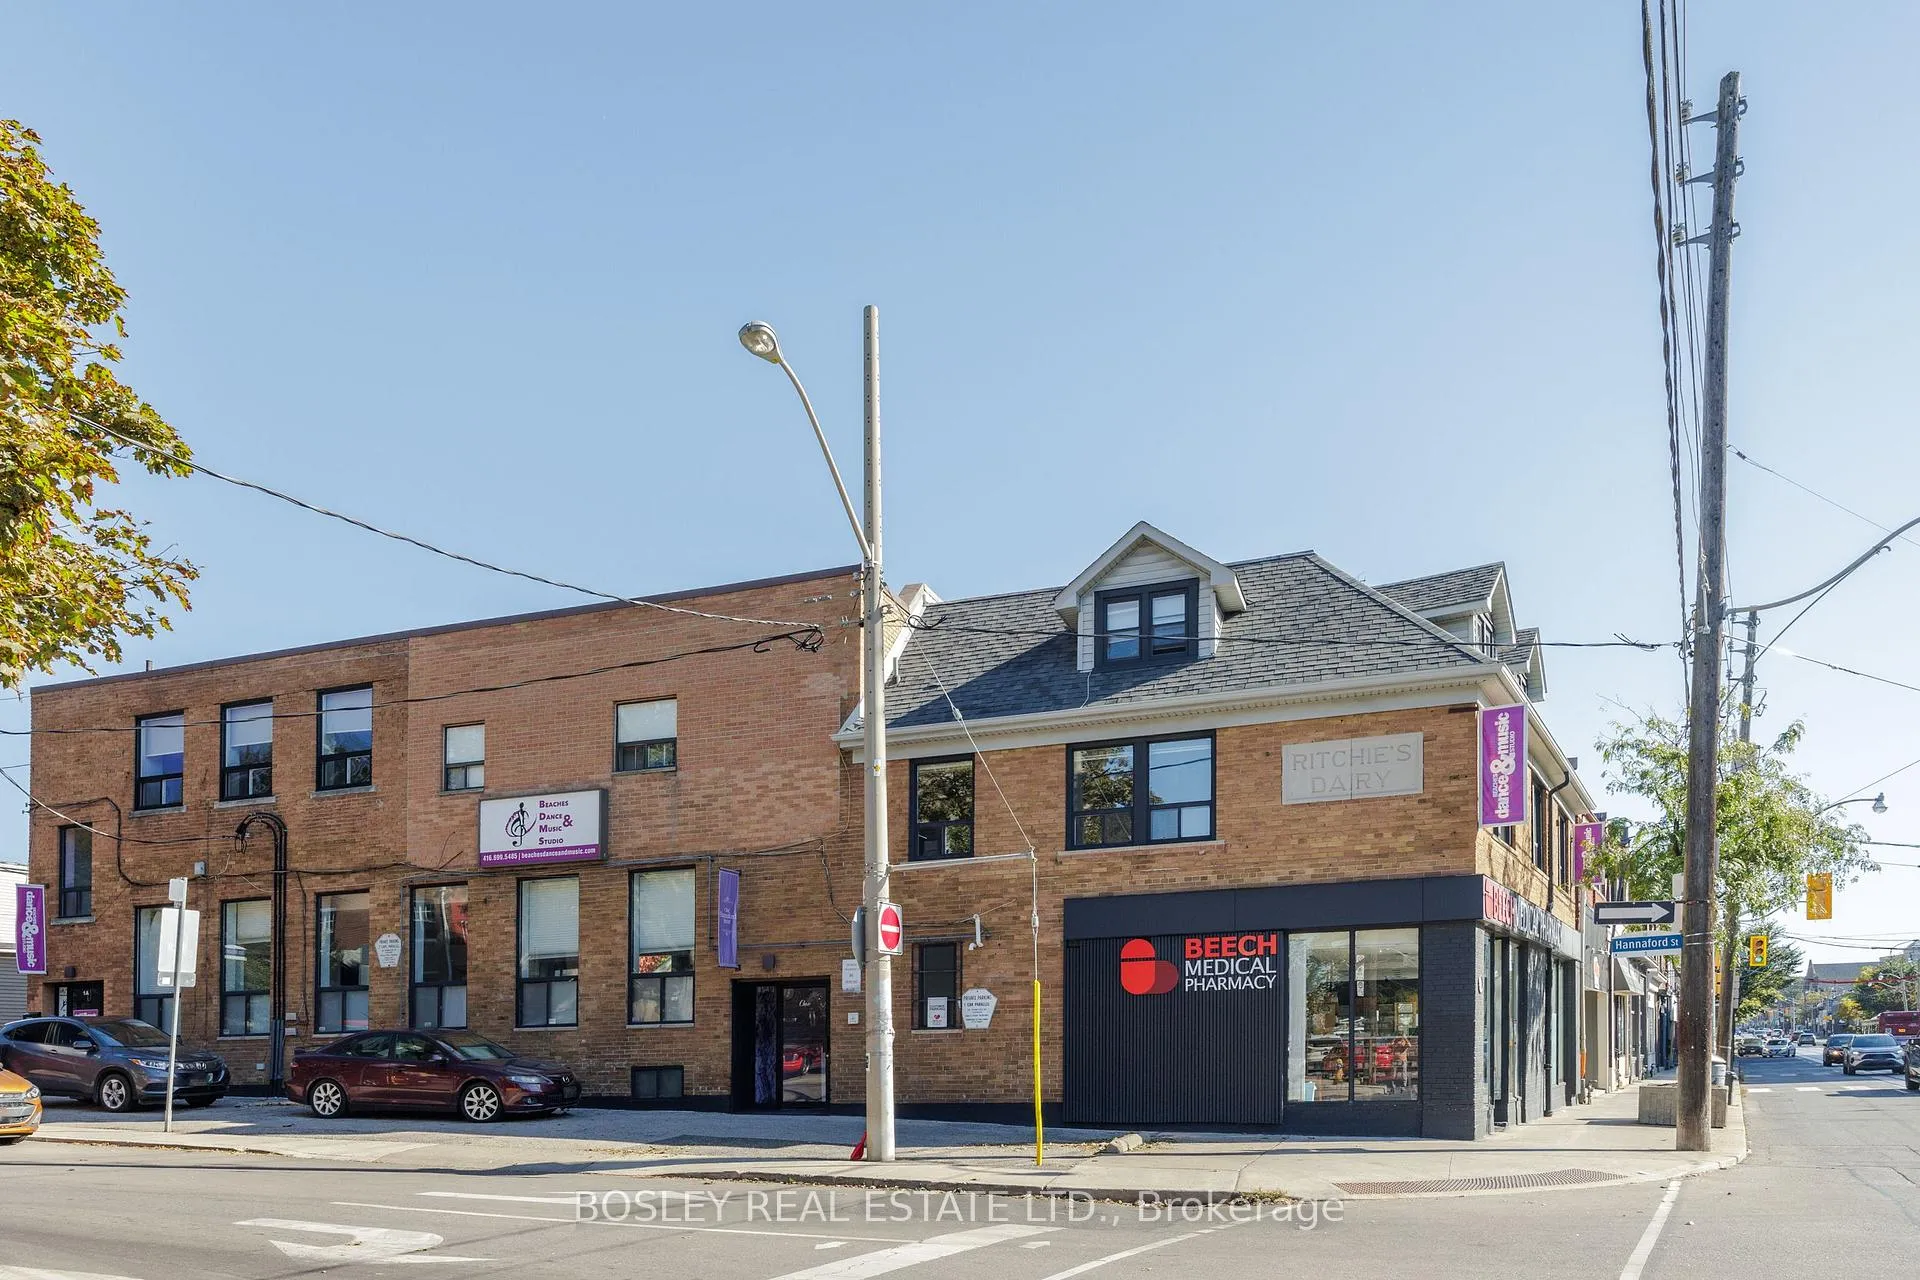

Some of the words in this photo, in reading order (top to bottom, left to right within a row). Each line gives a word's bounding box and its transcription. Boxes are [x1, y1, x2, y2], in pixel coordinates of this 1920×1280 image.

[1292, 744, 1412, 771] RITCHIE'S
[1311, 770, 1391, 794] DAIRY
[539, 800, 569, 809] BEACHES
[539, 812, 563, 821] DANCE
[539, 825, 562, 833] MUSIC
[538, 837, 564, 846] STUDIO
[1185, 934, 1277, 958] BEECH
[1615, 937, 1668, 950] Hannaford
[1670, 938, 1679, 946] St
[1185, 957, 1277, 976] MEDICAL
[1185, 975, 1277, 992] PHARMACY
